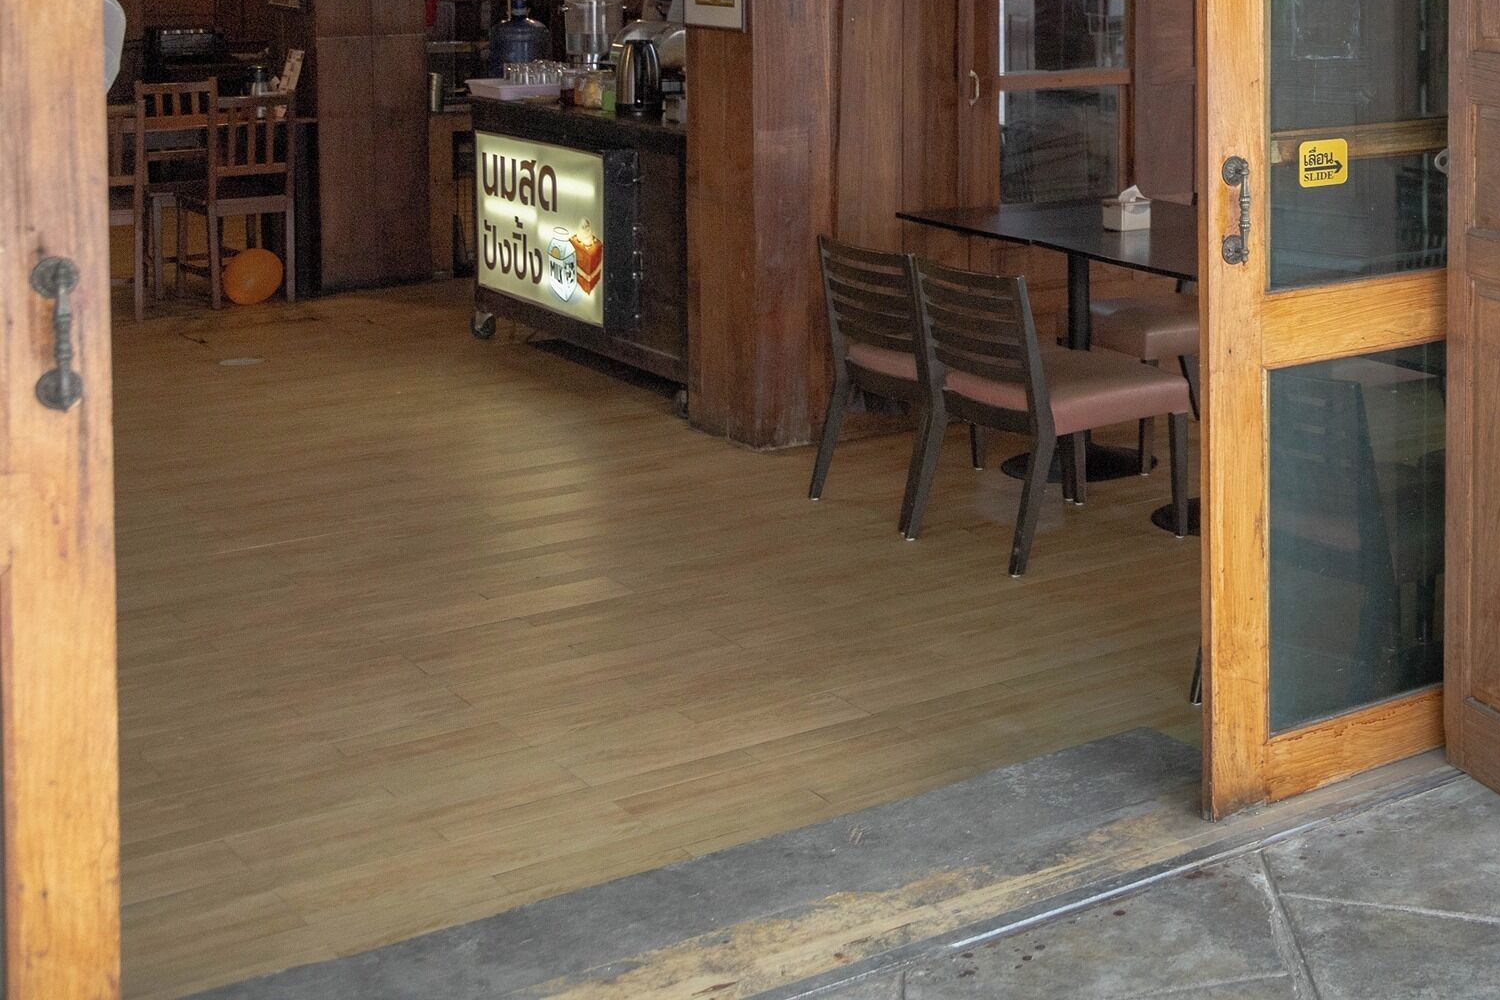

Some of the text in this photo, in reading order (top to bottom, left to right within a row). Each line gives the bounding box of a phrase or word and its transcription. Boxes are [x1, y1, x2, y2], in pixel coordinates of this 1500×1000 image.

[1303, 147, 1333, 166] เลื่อน
[1303, 170, 1334, 182] SLIDE
[482, 152, 558, 213] นมสด
[483, 215, 543, 285] ปังปิ้ง
